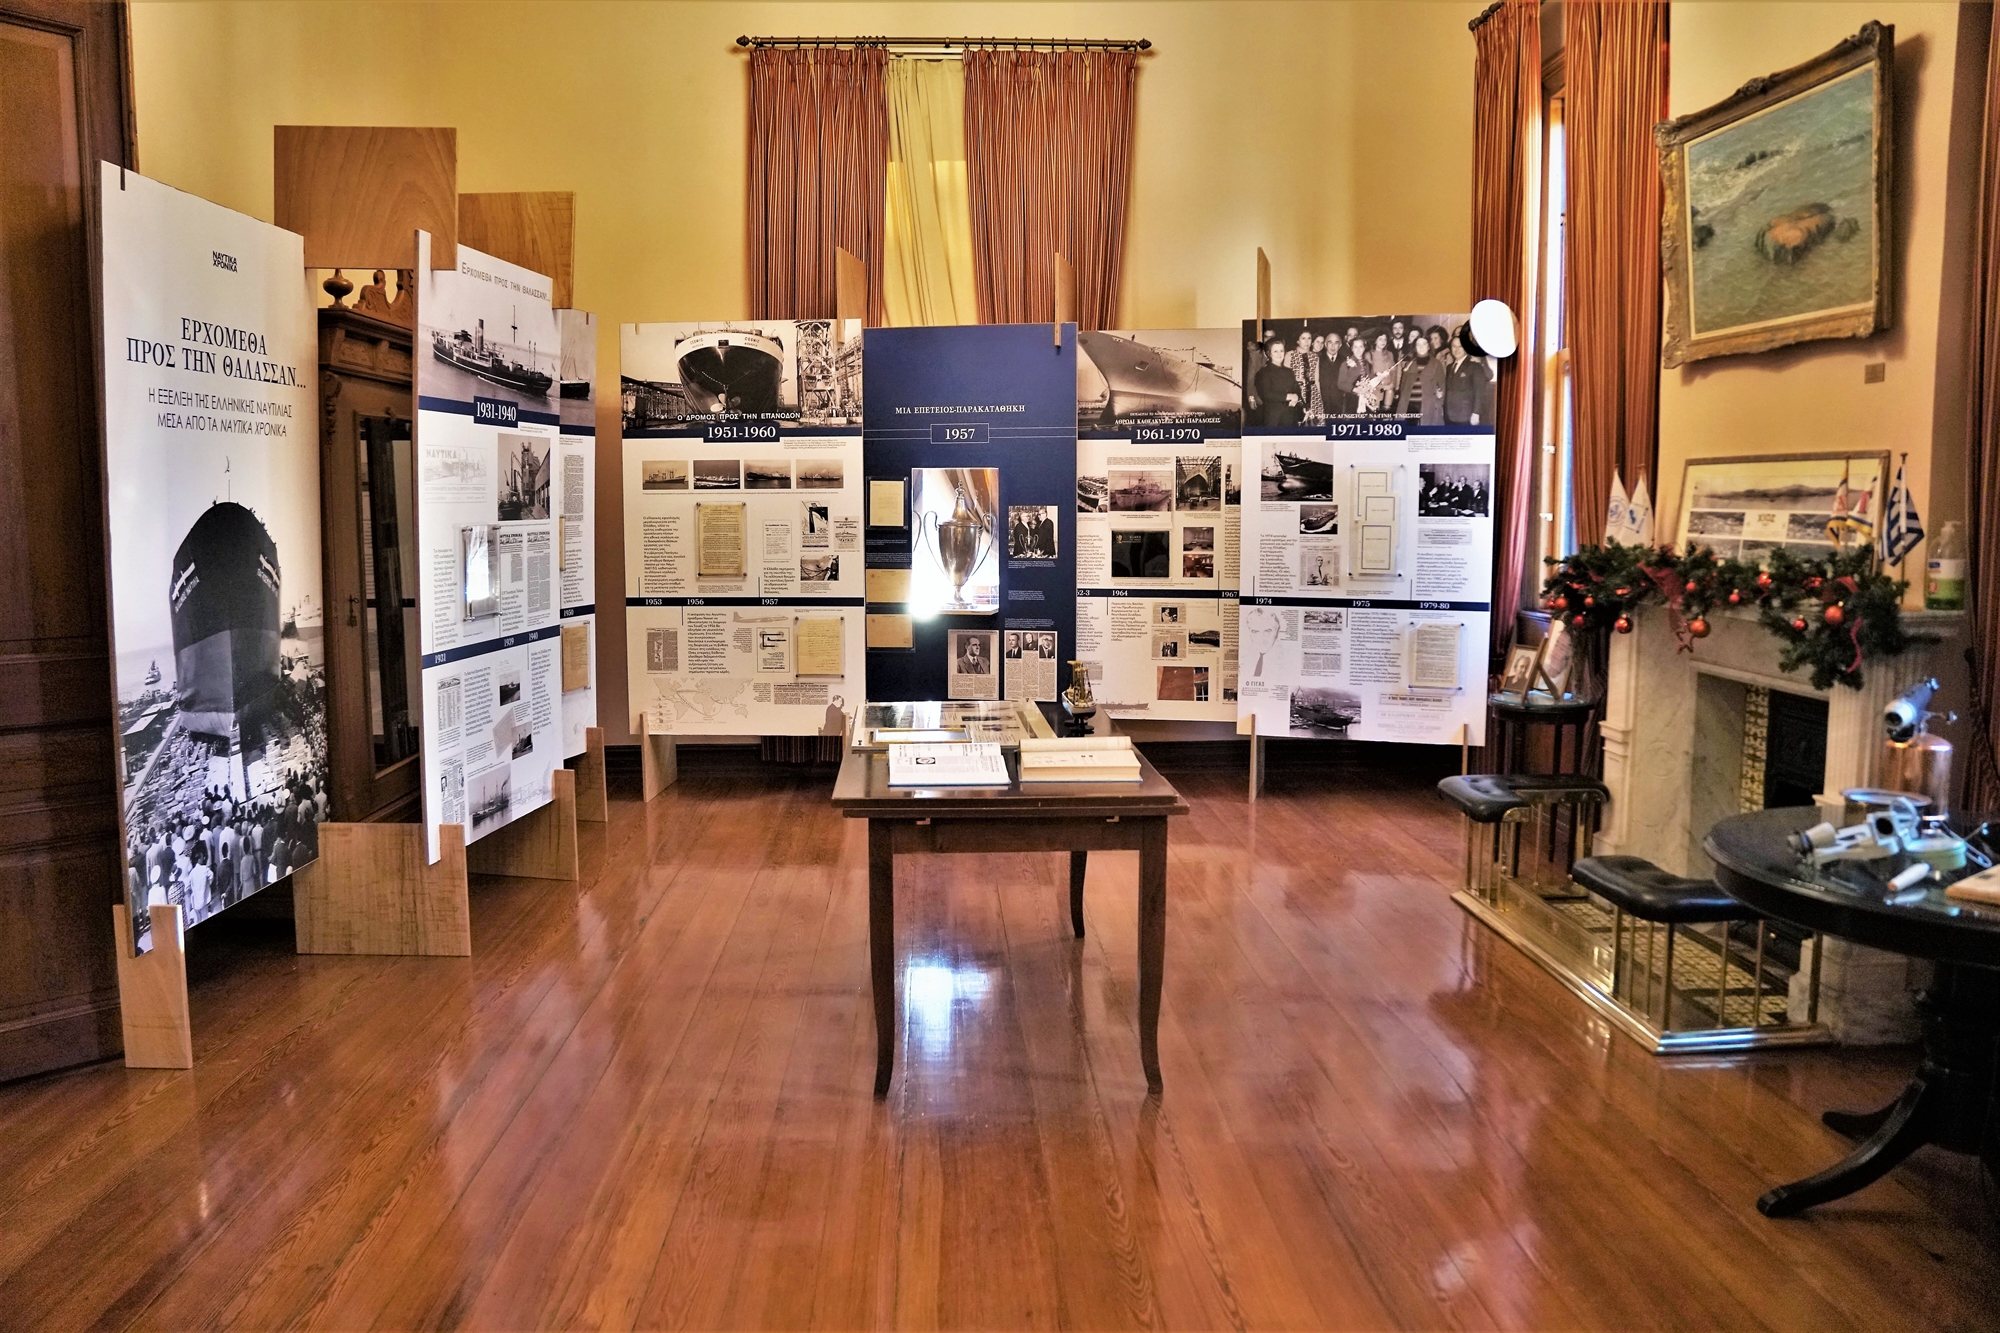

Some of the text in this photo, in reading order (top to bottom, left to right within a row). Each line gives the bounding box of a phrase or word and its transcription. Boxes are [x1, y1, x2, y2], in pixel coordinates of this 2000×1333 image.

[212, 250, 238, 266] ΝΑΥΤΙΚΑ
[212, 260, 238, 273] ΧΡΟΝΙΚΑ
[180, 317, 268, 356] ΕΡΧΟΜΕΘΑ
[126, 337, 306, 388] ΠΡΟΣ ΤΗΝ ΘΑΛΑΣΣΑΝ...
[148, 387, 292, 418] Η ΕΞΕΛΙΞΗ ΤΗΣ ΕΛΛΗΝΙΚΗΣ ΝΑΥΤΙΛΙΑΣ
[476, 402, 517, 422] 1931-1940
[914, 404, 1026, 414] ΕΠΕΤΕΙΟΣ-ΠΑΡΑΚΑΤΑΘΗΚΗ
[686, 414, 716, 422] ΔΡΟΜΟΣ
[760, 412, 801, 420] ΕΠΑΝΟΔΟΝ
[157, 412, 287, 438] ΜΕΣΑ ΑΠΟ ΤΑ ΝΑΥΤΙΚΑ ΧΡΟΝΙΚΑ
[1331, 424, 1402, 436] 1971-1980
[708, 426, 776, 439] 1951-1960
[945, 428, 976, 440] 1957
[1136, 428, 1200, 440] 1961-1970
[426, 448, 457, 459] ΝΑΥΤΙΚΑ
[564, 608, 574, 617] 1950
[528, 632, 538, 641] 1940
[434, 653, 446, 664] 1931
